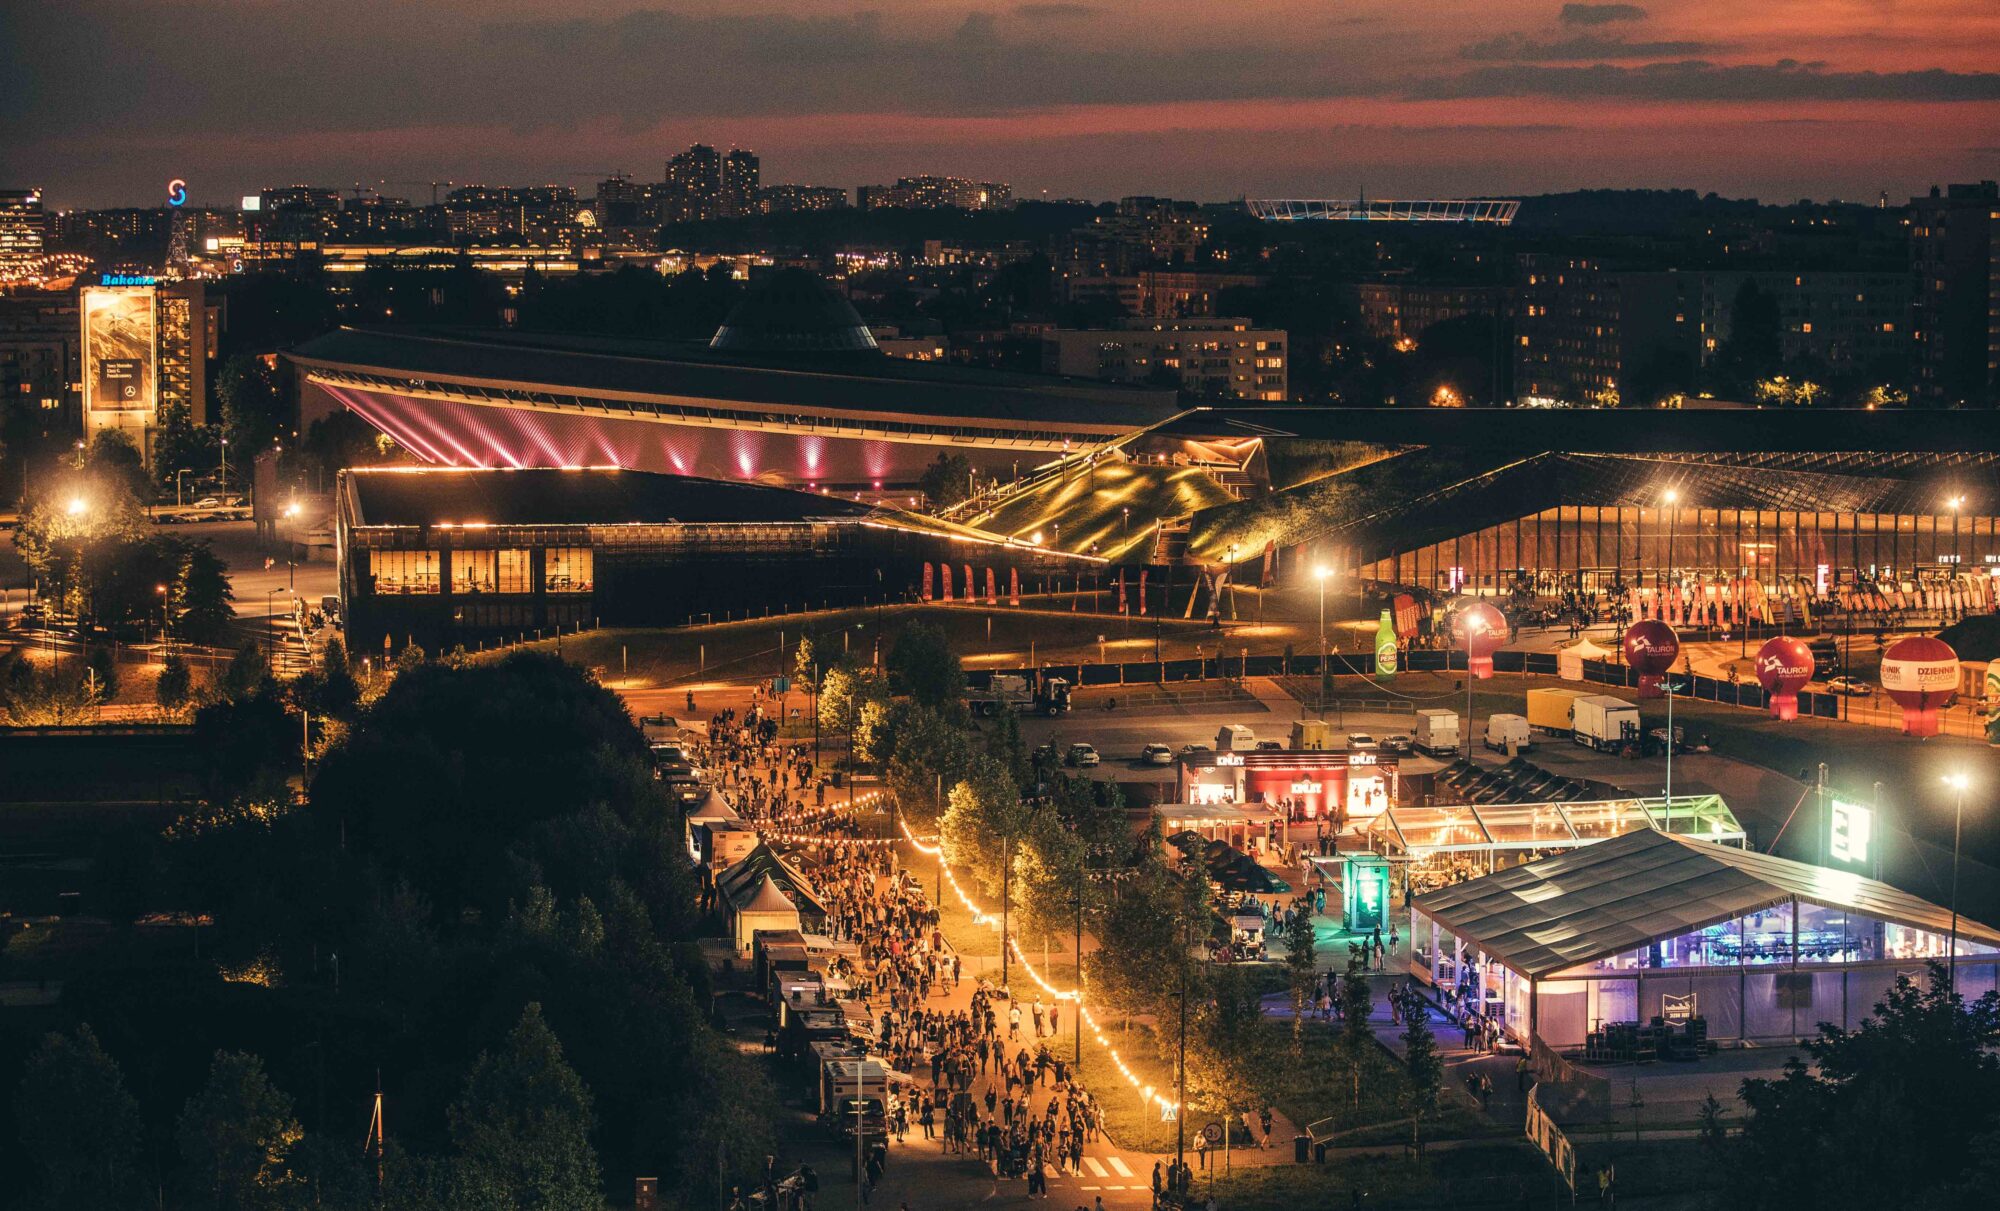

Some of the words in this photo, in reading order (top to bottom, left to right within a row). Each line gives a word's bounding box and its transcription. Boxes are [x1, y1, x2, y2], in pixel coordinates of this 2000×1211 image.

[102, 274, 155, 286] Bakoma
[1777, 666, 1808, 675] TAURON
[1918, 665, 1955, 675] DZIENNIK
